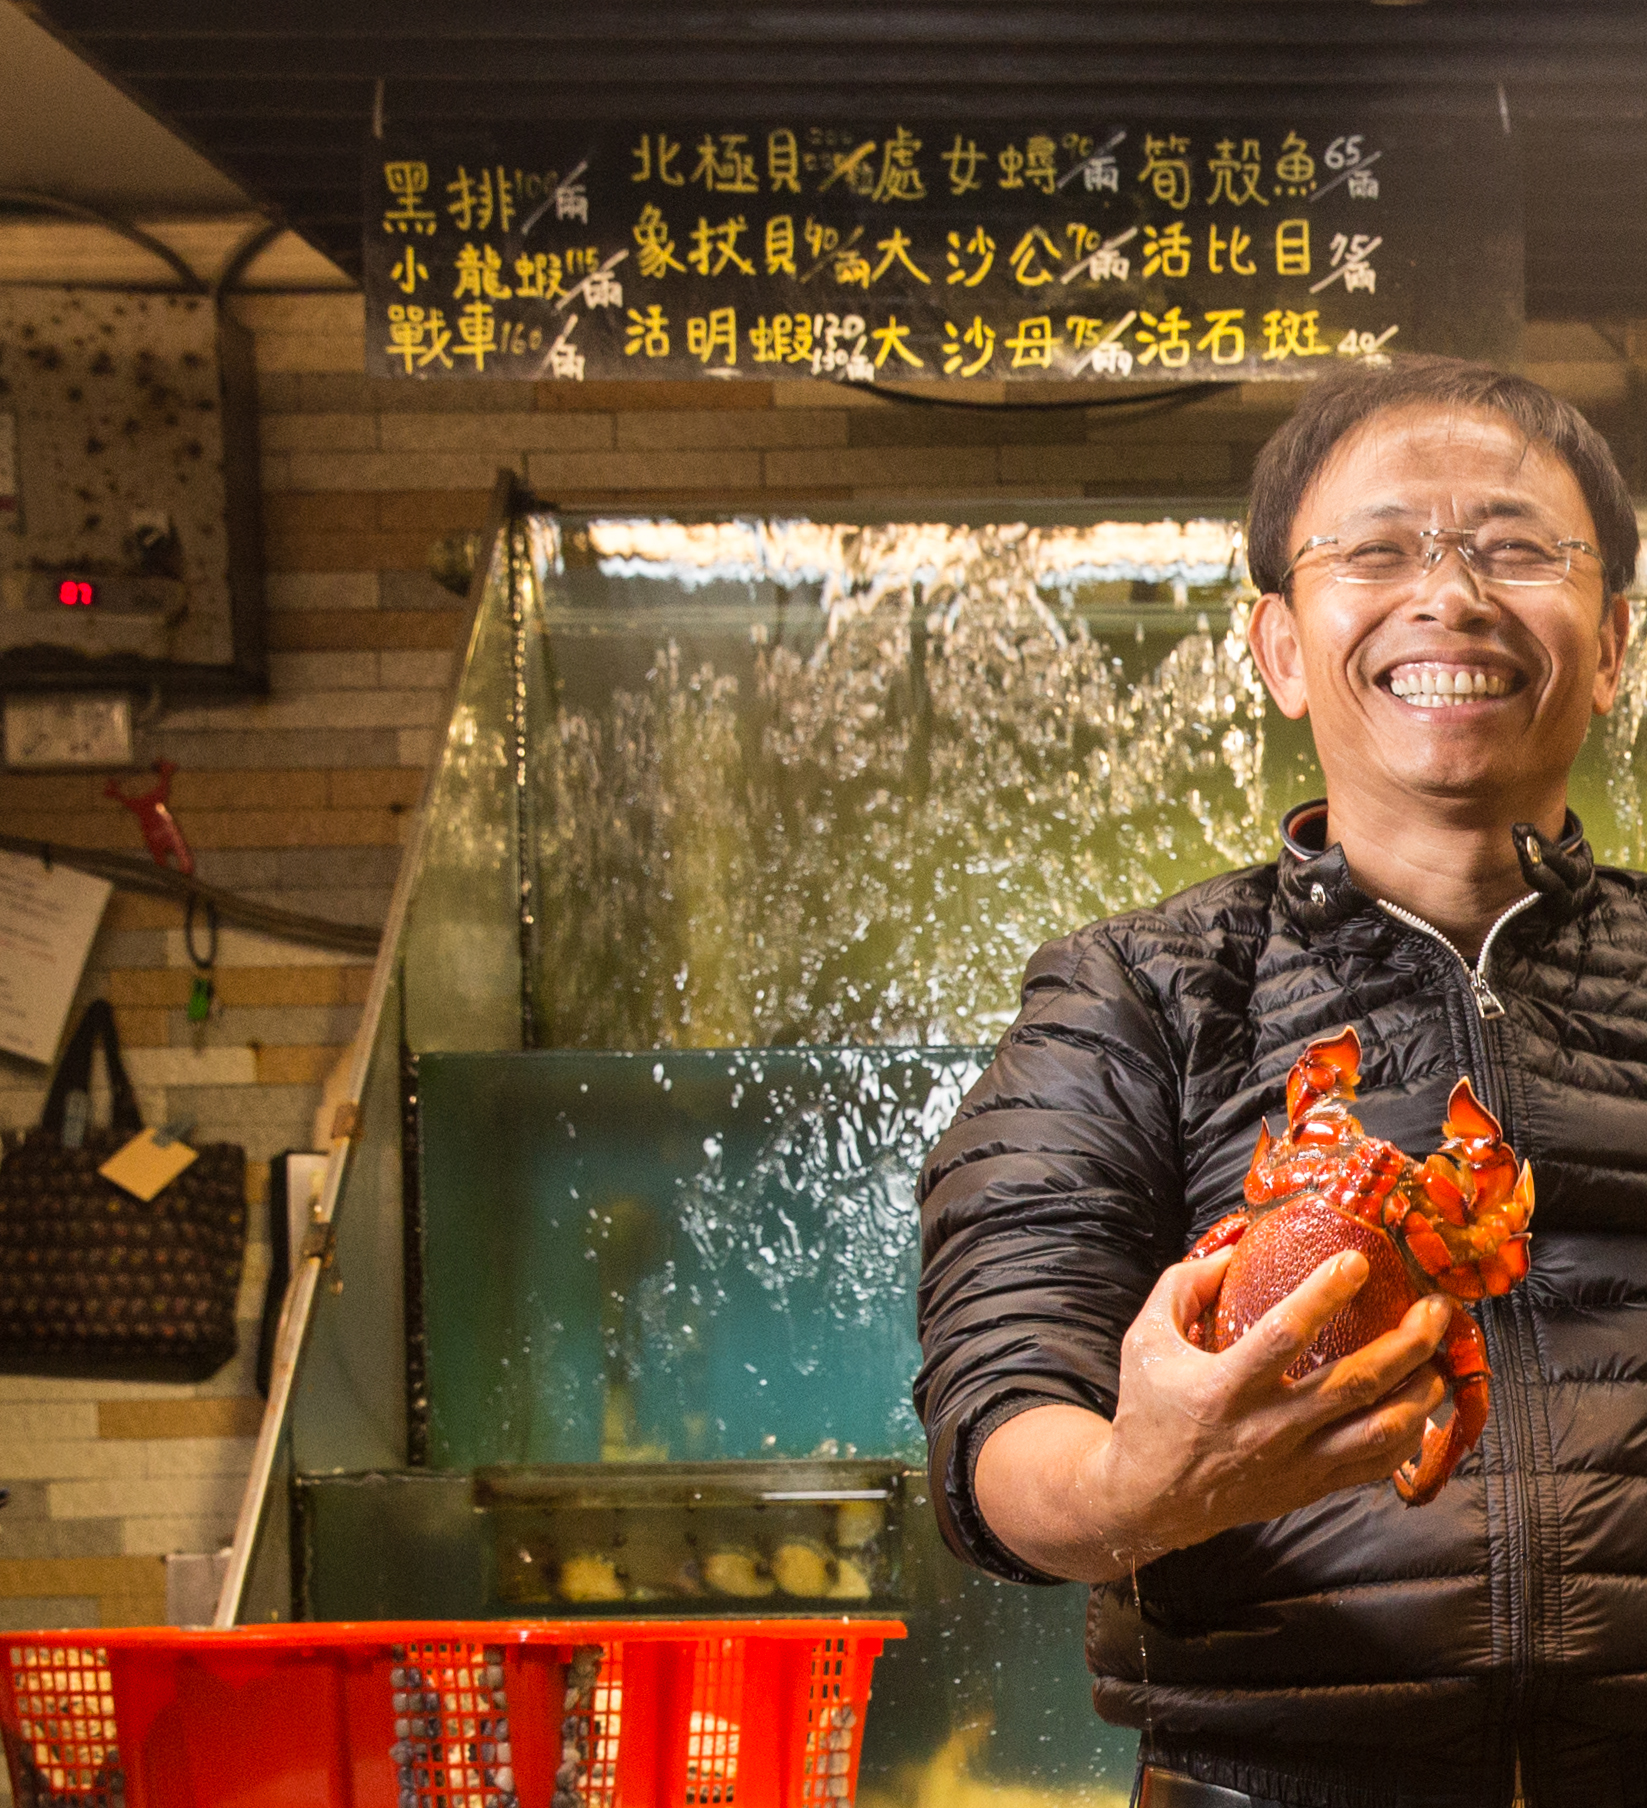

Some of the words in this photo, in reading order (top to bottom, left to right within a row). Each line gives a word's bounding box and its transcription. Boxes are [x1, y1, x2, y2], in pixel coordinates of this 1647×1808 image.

[383, 161, 515, 234] 黑排
[391, 242, 567, 299] 小龍蝦
[871, 224, 1062, 287] 大沙公
[1142, 218, 1311, 277] 活比目
[872, 315, 1062, 378] 大沙母
[1136, 306, 1331, 367] 活石斑
